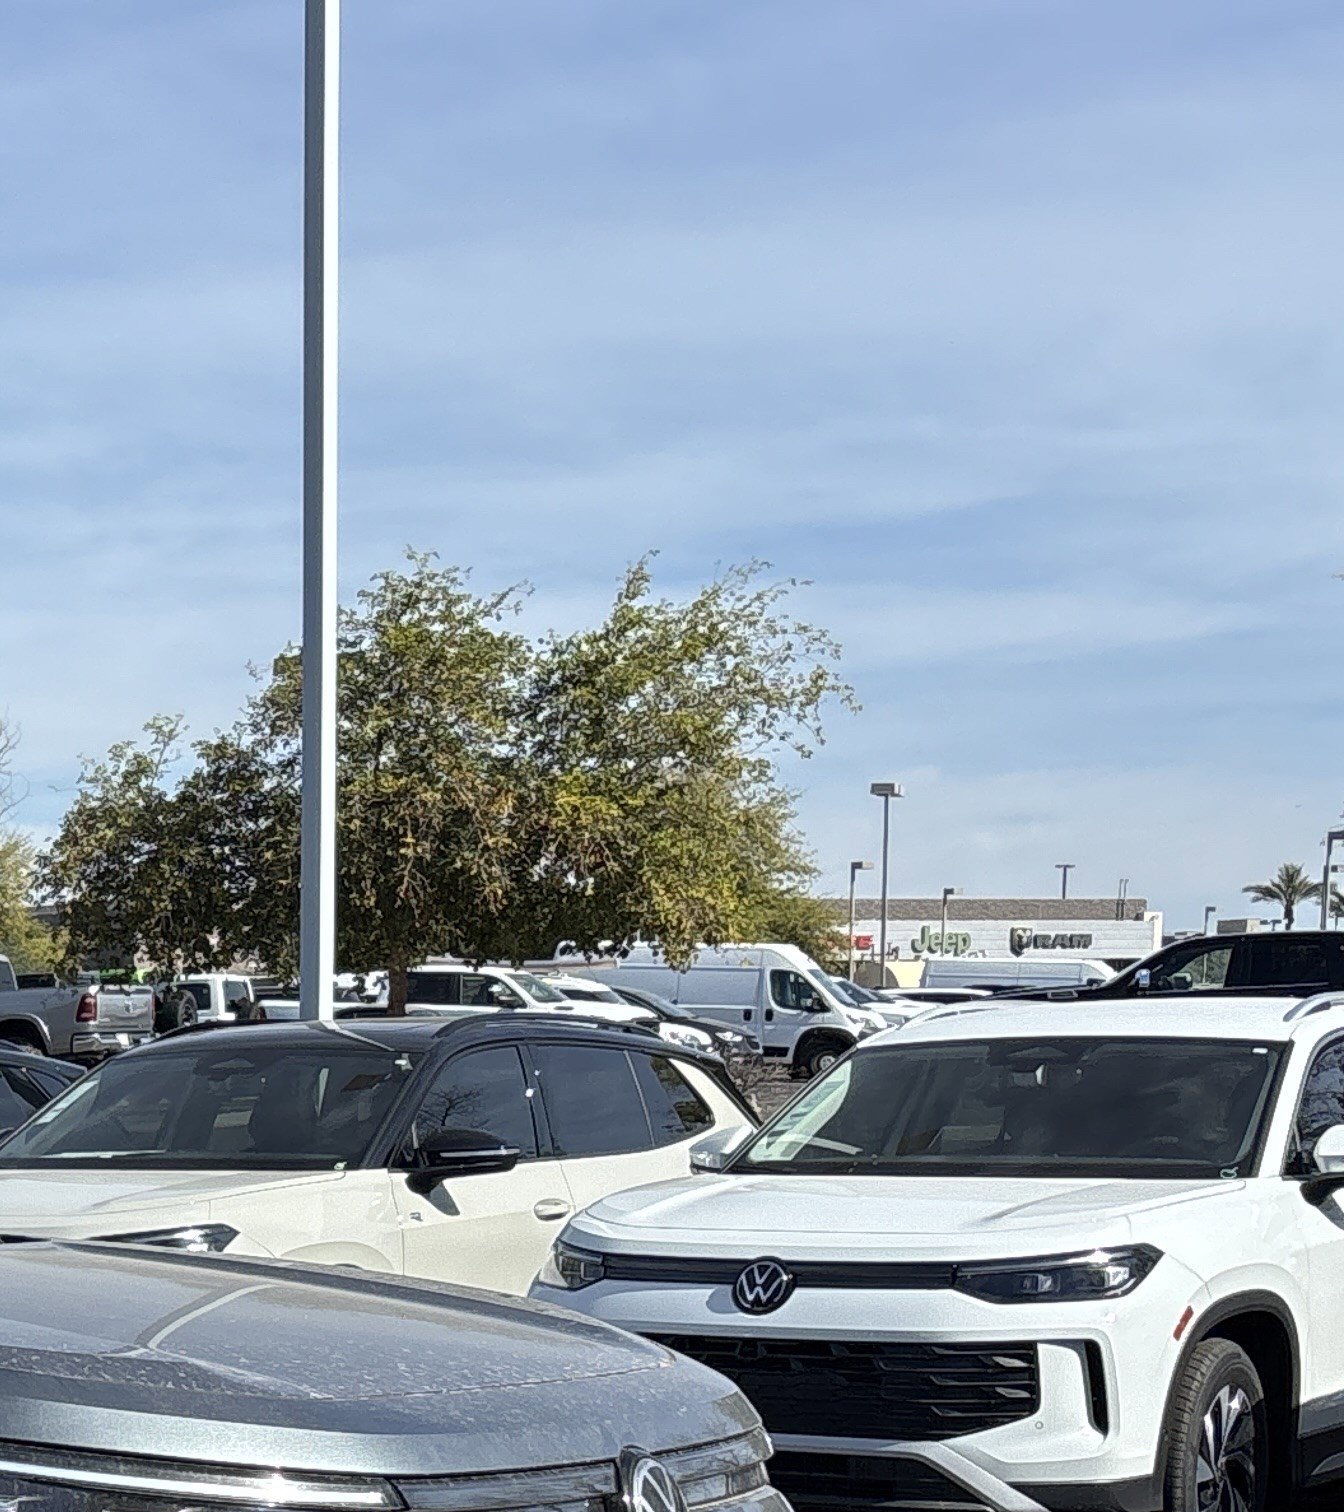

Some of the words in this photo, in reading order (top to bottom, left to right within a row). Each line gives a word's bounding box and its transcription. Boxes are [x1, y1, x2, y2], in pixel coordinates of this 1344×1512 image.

[911, 925, 972, 957] Jeep
[1033, 933, 1093, 950] RAM
[737, 1261, 787, 1307] VW
